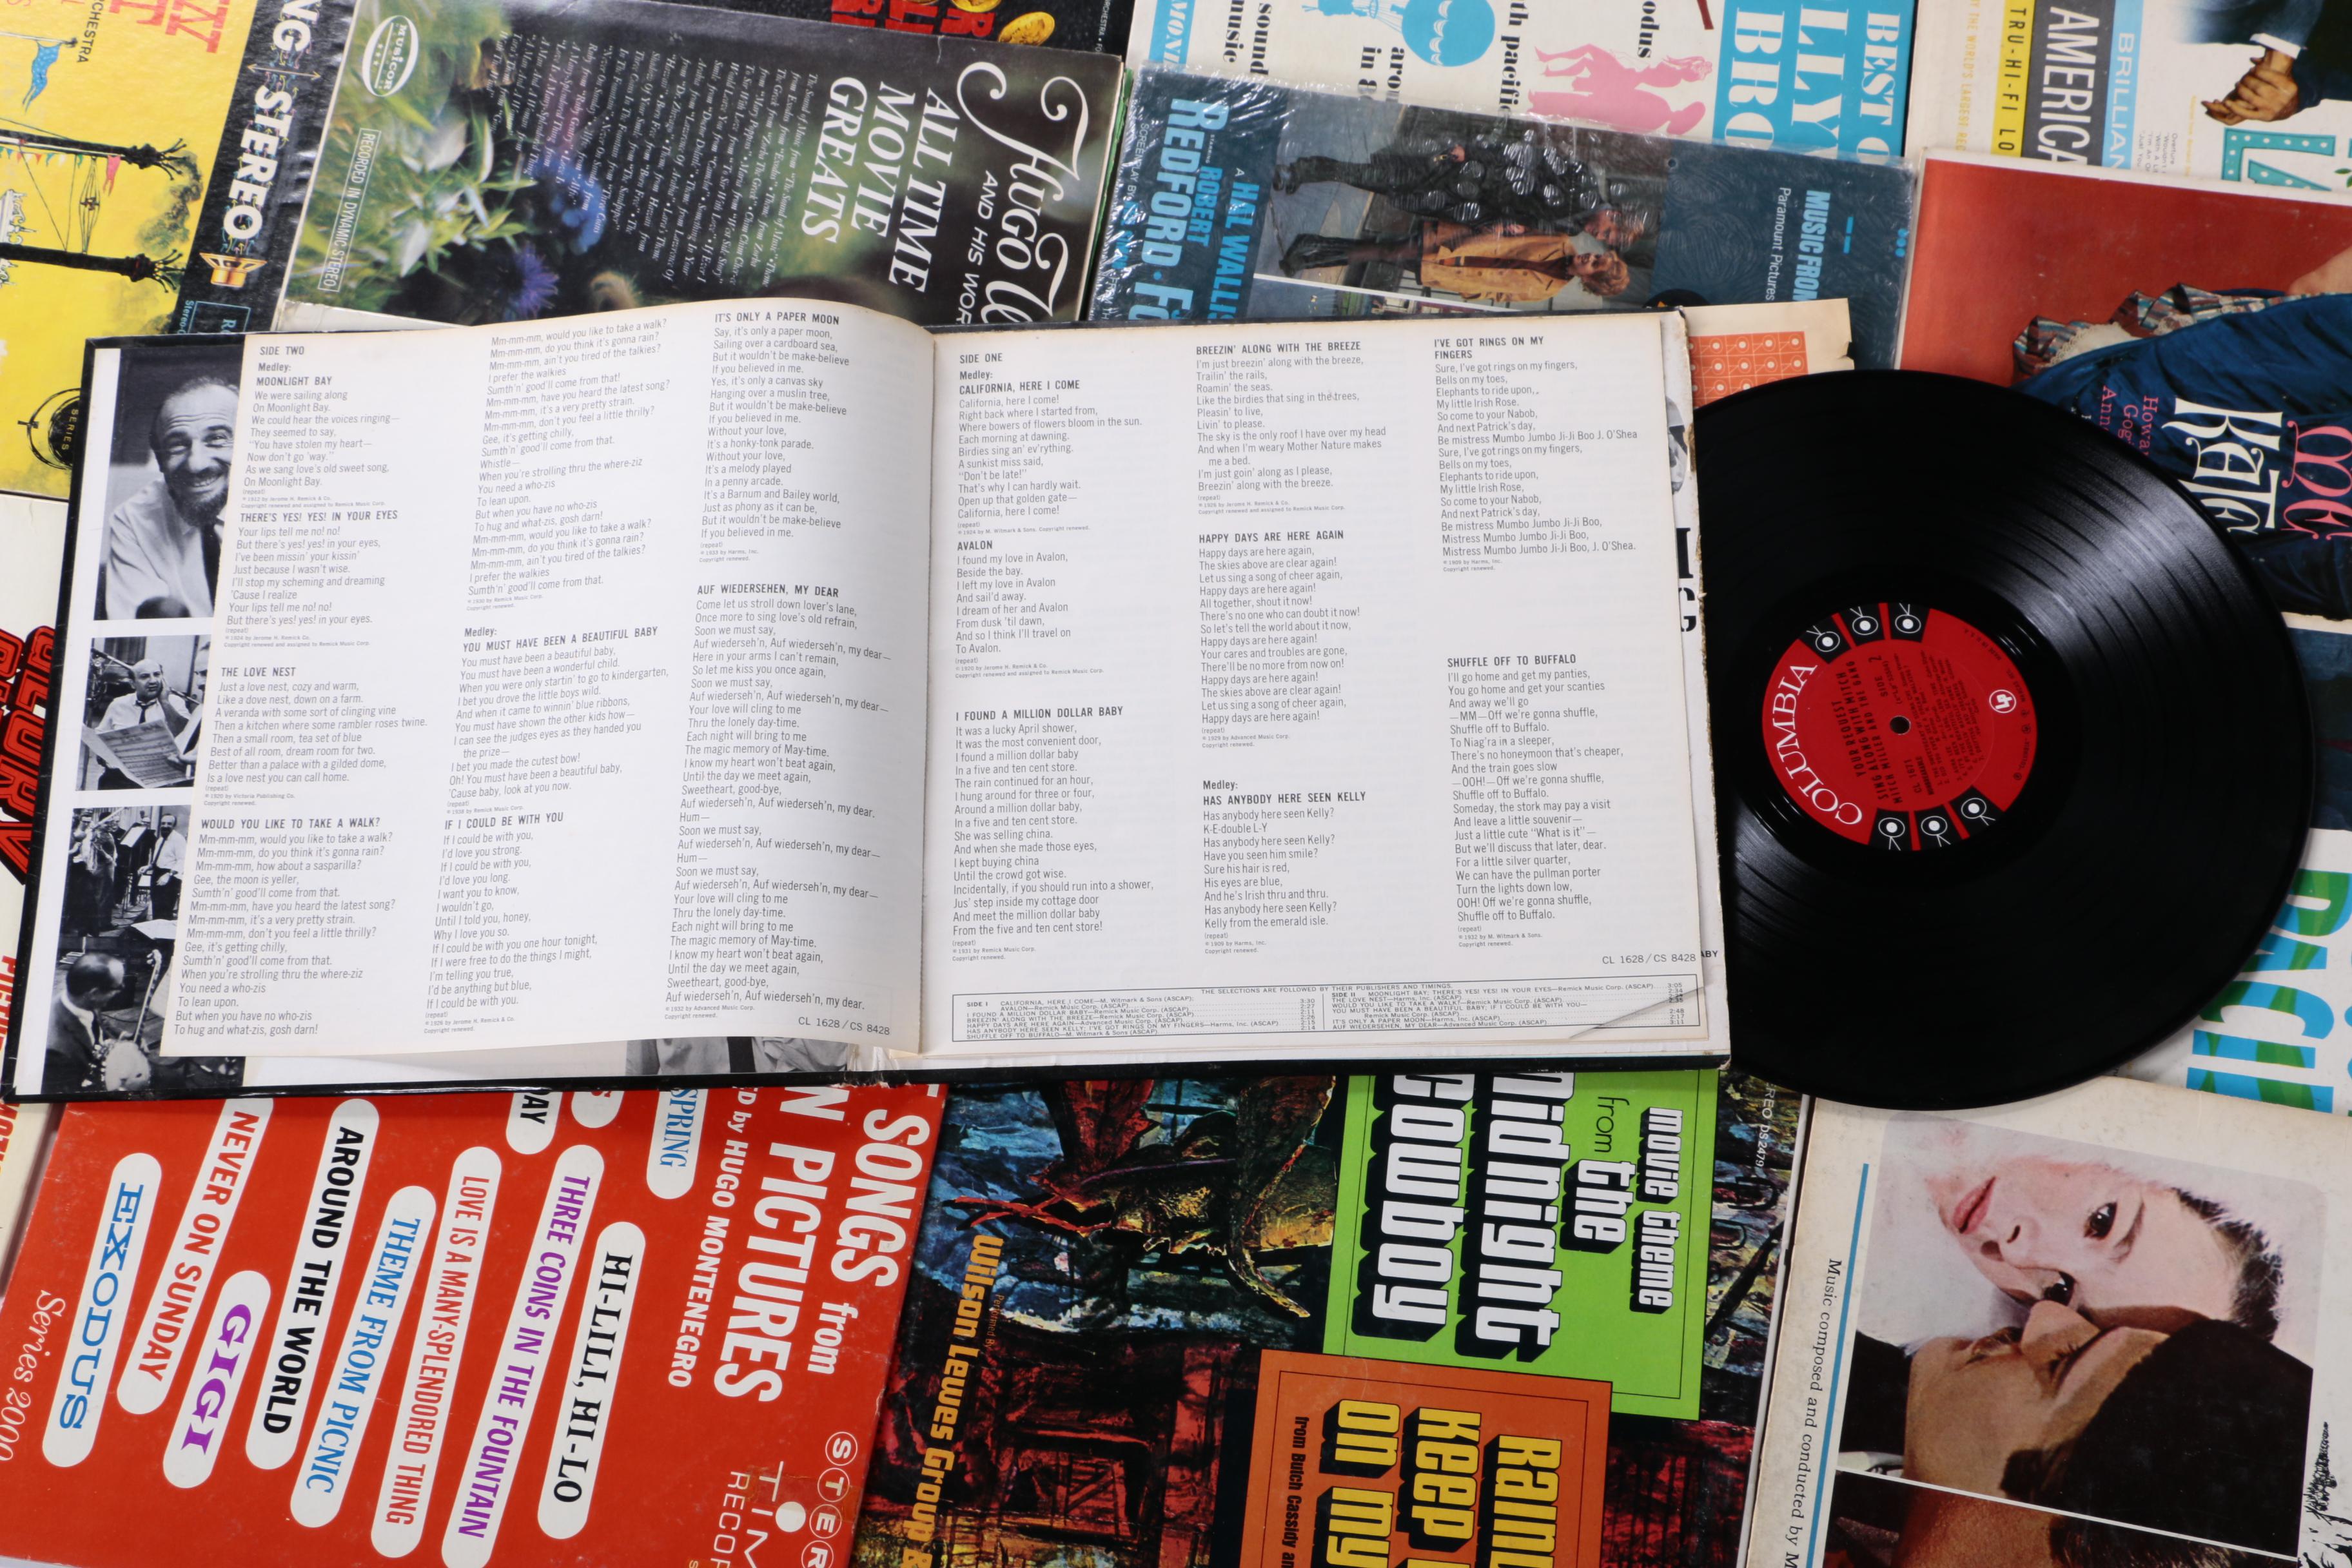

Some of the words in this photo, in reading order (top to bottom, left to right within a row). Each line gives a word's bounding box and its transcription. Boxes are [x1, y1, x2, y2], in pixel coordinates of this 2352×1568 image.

[1250, 3, 1273, 75] sound
[1860, 10, 1900, 126] BEST
[913, 88, 961, 168] ALL
[223, 84, 295, 239] STEREO
[351, 133, 375, 184] RECORDED
[801, 76, 868, 244] GREATS
[851, 81, 916, 238] MOVIE
[1142, 99, 1229, 267] REDFORD
[1235, 168, 1244, 177] A
[348, 188, 362, 199] IN
[977, 171, 998, 219] AND
[1187, 166, 1222, 247] ROBERT
[1226, 182, 1259, 228] HAL
[335, 202, 357, 247] DYNAMIC
[888, 172, 949, 293] TIME
[968, 227, 988, 266] HIS
[1770, 187, 1792, 257] Paramount
[1799, 190, 1831, 254] MUSIC
[323, 250, 344, 287] STEREO
[1765, 254, 1783, 301] Pictures
[715, 313, 730, 323] IT'S
[737, 312, 761, 322] ONLY
[777, 311, 806, 322] PAPER
[812, 313, 839, 325] MOON
[260, 346, 280, 355] SIDE
[286, 346, 304, 355] TWO
[960, 353, 979, 364] SIDE
[985, 353, 1002, 363] ONE
[257, 377, 309, 386] MOONLIGHT
[315, 377, 332, 386] BAY
[959, 382, 1015, 395] CALIFORNIA,
[1020, 380, 1042, 391] HERE
[1055, 380, 1080, 390] COME
[62, 408, 79, 450] SERIES
[1440, 473, 1483, 484] Elephants
[1485, 473, 1493, 482] to
[1495, 472, 1512, 482] ride
[1514, 471, 1538, 482] upon,
[1199, 534, 1228, 544] HAPPY
[1235, 533, 1258, 542] DAYS
[1264, 532, 1281, 542] ARE
[1288, 531, 1310, 541] HERE
[1317, 530, 1344, 540] AGAIN
[697, 585, 715, 595] AUF
[721, 583, 788, 597] WIEDERSEHEN,
[795, 585, 808, 594] MY
[815, 586, 838, 598] DEAR
[222, 667, 239, 677] THE
[244, 667, 267, 677] LOVE
[273, 667, 296, 677] NEST
[1447, 657, 1488, 667] SHUFFLE
[1494, 656, 1511, 666] OFF
[1517, 656, 1528, 665] TO
[1534, 654, 1576, 665] BUFFALO
[1846, 661, 1861, 686] GANG
[1836, 672, 1856, 704] MITCH
[1856, 691, 1868, 707] THE
[1875, 675, 1888, 697] SIDE
[1772, 664, 1863, 825] COLUMBIA
[1831, 701, 1855, 746] REQUEST
[1849, 707, 1865, 734] WITH
[1865, 712, 1877, 730] AND
[1849, 749, 1867, 777] YOUR
[1859, 737, 1878, 771] ALONG
[1872, 735, 1890, 769] MILLER
[1872, 775, 1888, 800] SING
[1886, 774, 1903, 803] MITCH
[1912, 782, 1922, 794] CL
[667, 977, 721, 990] Sweetheart,
[725, 977, 769, 990] good-bye,
[1602, 956, 1614, 964] CL
[1671, 954, 1696, 962] 8428
[727, 1110, 752, 1133] by
[1594, 1096, 1629, 1153] from
[202, 1111, 260, 1206] NEVER
[712, 1139, 749, 1208] HUGO
[1645, 1106, 1683, 1198] movie
[311, 1126, 365, 1250] AROUND
[455, 1175, 490, 1221] LOVE
[546, 1175, 591, 1246] THREE
[831, 1109, 930, 1288] SONGS
[1574, 1159, 1636, 1242] the
[183, 1213, 221, 1255] ON
[445, 1249, 472, 1264] A
[449, 1226, 476, 1247] IS
[1638, 1210, 1681, 1308] theme
[293, 1259, 333, 1316] THE
[366, 1218, 422, 1309] THEME
[525, 1252, 566, 1321] COINS
[714, 1142, 836, 1402] PICTURES
[953, 1234, 1003, 1336] Wilson
[1823, 1258, 1843, 1307] Music
[59, 1182, 144, 1429] EXODUS
[137, 1262, 202, 1382] SUNDAY
[572, 1251, 633, 1387] HI-LILI,
[668, 1215, 730, 1388] MONTENEGRO
[988, 1294, 1004, 1337] Performed
[14, 1289, 66, 1383] Series
[338, 1314, 388, 1395] FROM
[514, 1326, 545, 1355] IN
[808, 1301, 859, 1375] from
[1810, 1312, 1830, 1391] composed
[181, 1303, 251, 1455] GIGI
[262, 1326, 316, 1434] WORLD
[403, 1268, 469, 1455] MANY-SPLENDORED
[497, 1364, 534, 1409] THE
[930, 1344, 979, 1442] Lewes
[1805, 1397, 1818, 1428] and
[0, 1387, 32, 1461] 2000
[306, 1400, 359, 1494] PICNIC
[553, 1395, 602, 1502] HI-LO
[1292, 1416, 1309, 1449] from
[1335, 1399, 1401, 1466] on
[386, 1463, 426, 1525] THING
[458, 1414, 518, 1538] FOUNTAIN
[904, 1447, 955, 1542] Group
[1288, 1453, 1306, 1491] Butch
[1411, 1407, 1482, 1540] Keep
[1791, 1435, 1811, 1518] conducted
[1282, 1496, 1302, 1545] Cassidy
[1787, 1526, 1803, 1547] by
